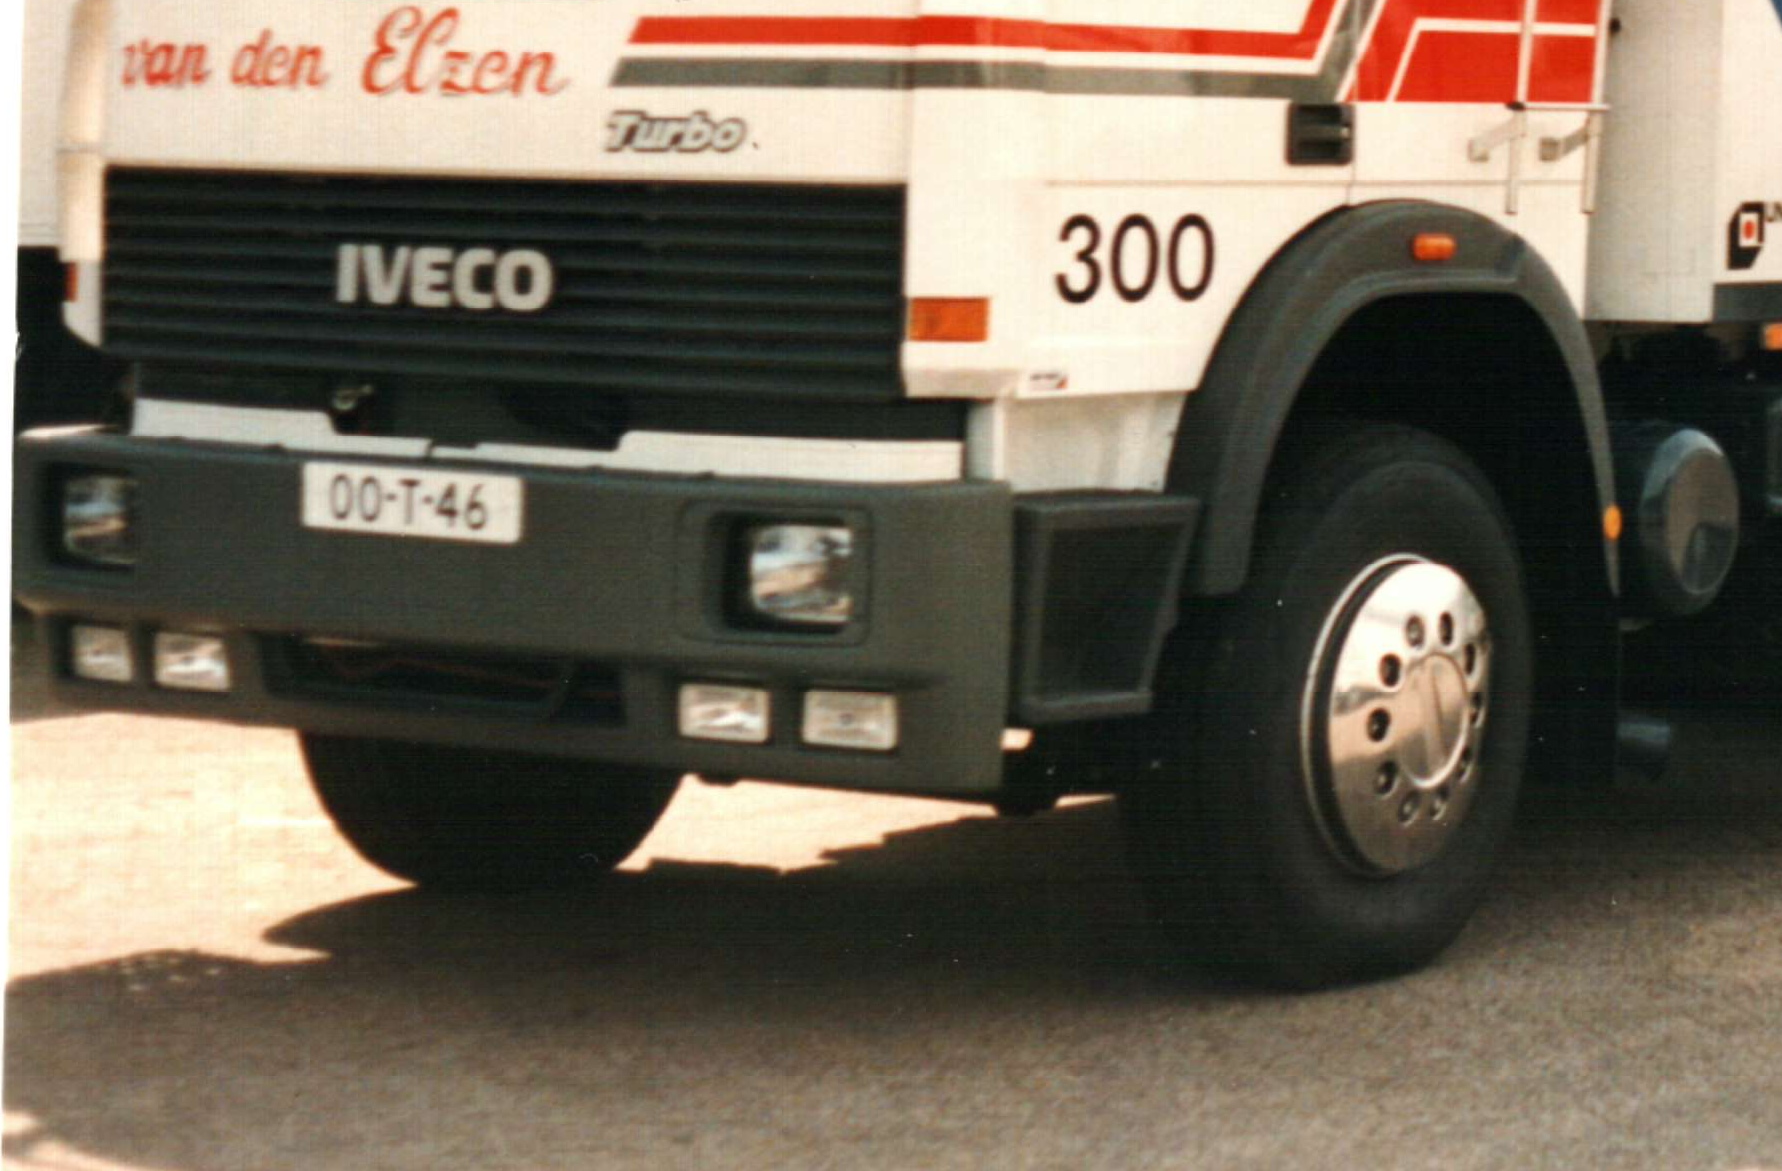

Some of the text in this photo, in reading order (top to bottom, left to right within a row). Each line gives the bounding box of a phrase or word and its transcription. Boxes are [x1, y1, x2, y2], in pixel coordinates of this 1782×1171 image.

[123, 6, 571, 97] van den Elzen
[603, 110, 748, 153] Turbo
[335, 242, 551, 312] IVECO
[1055, 213, 1216, 305] 300
[332, 473, 487, 530] 00-T-46
